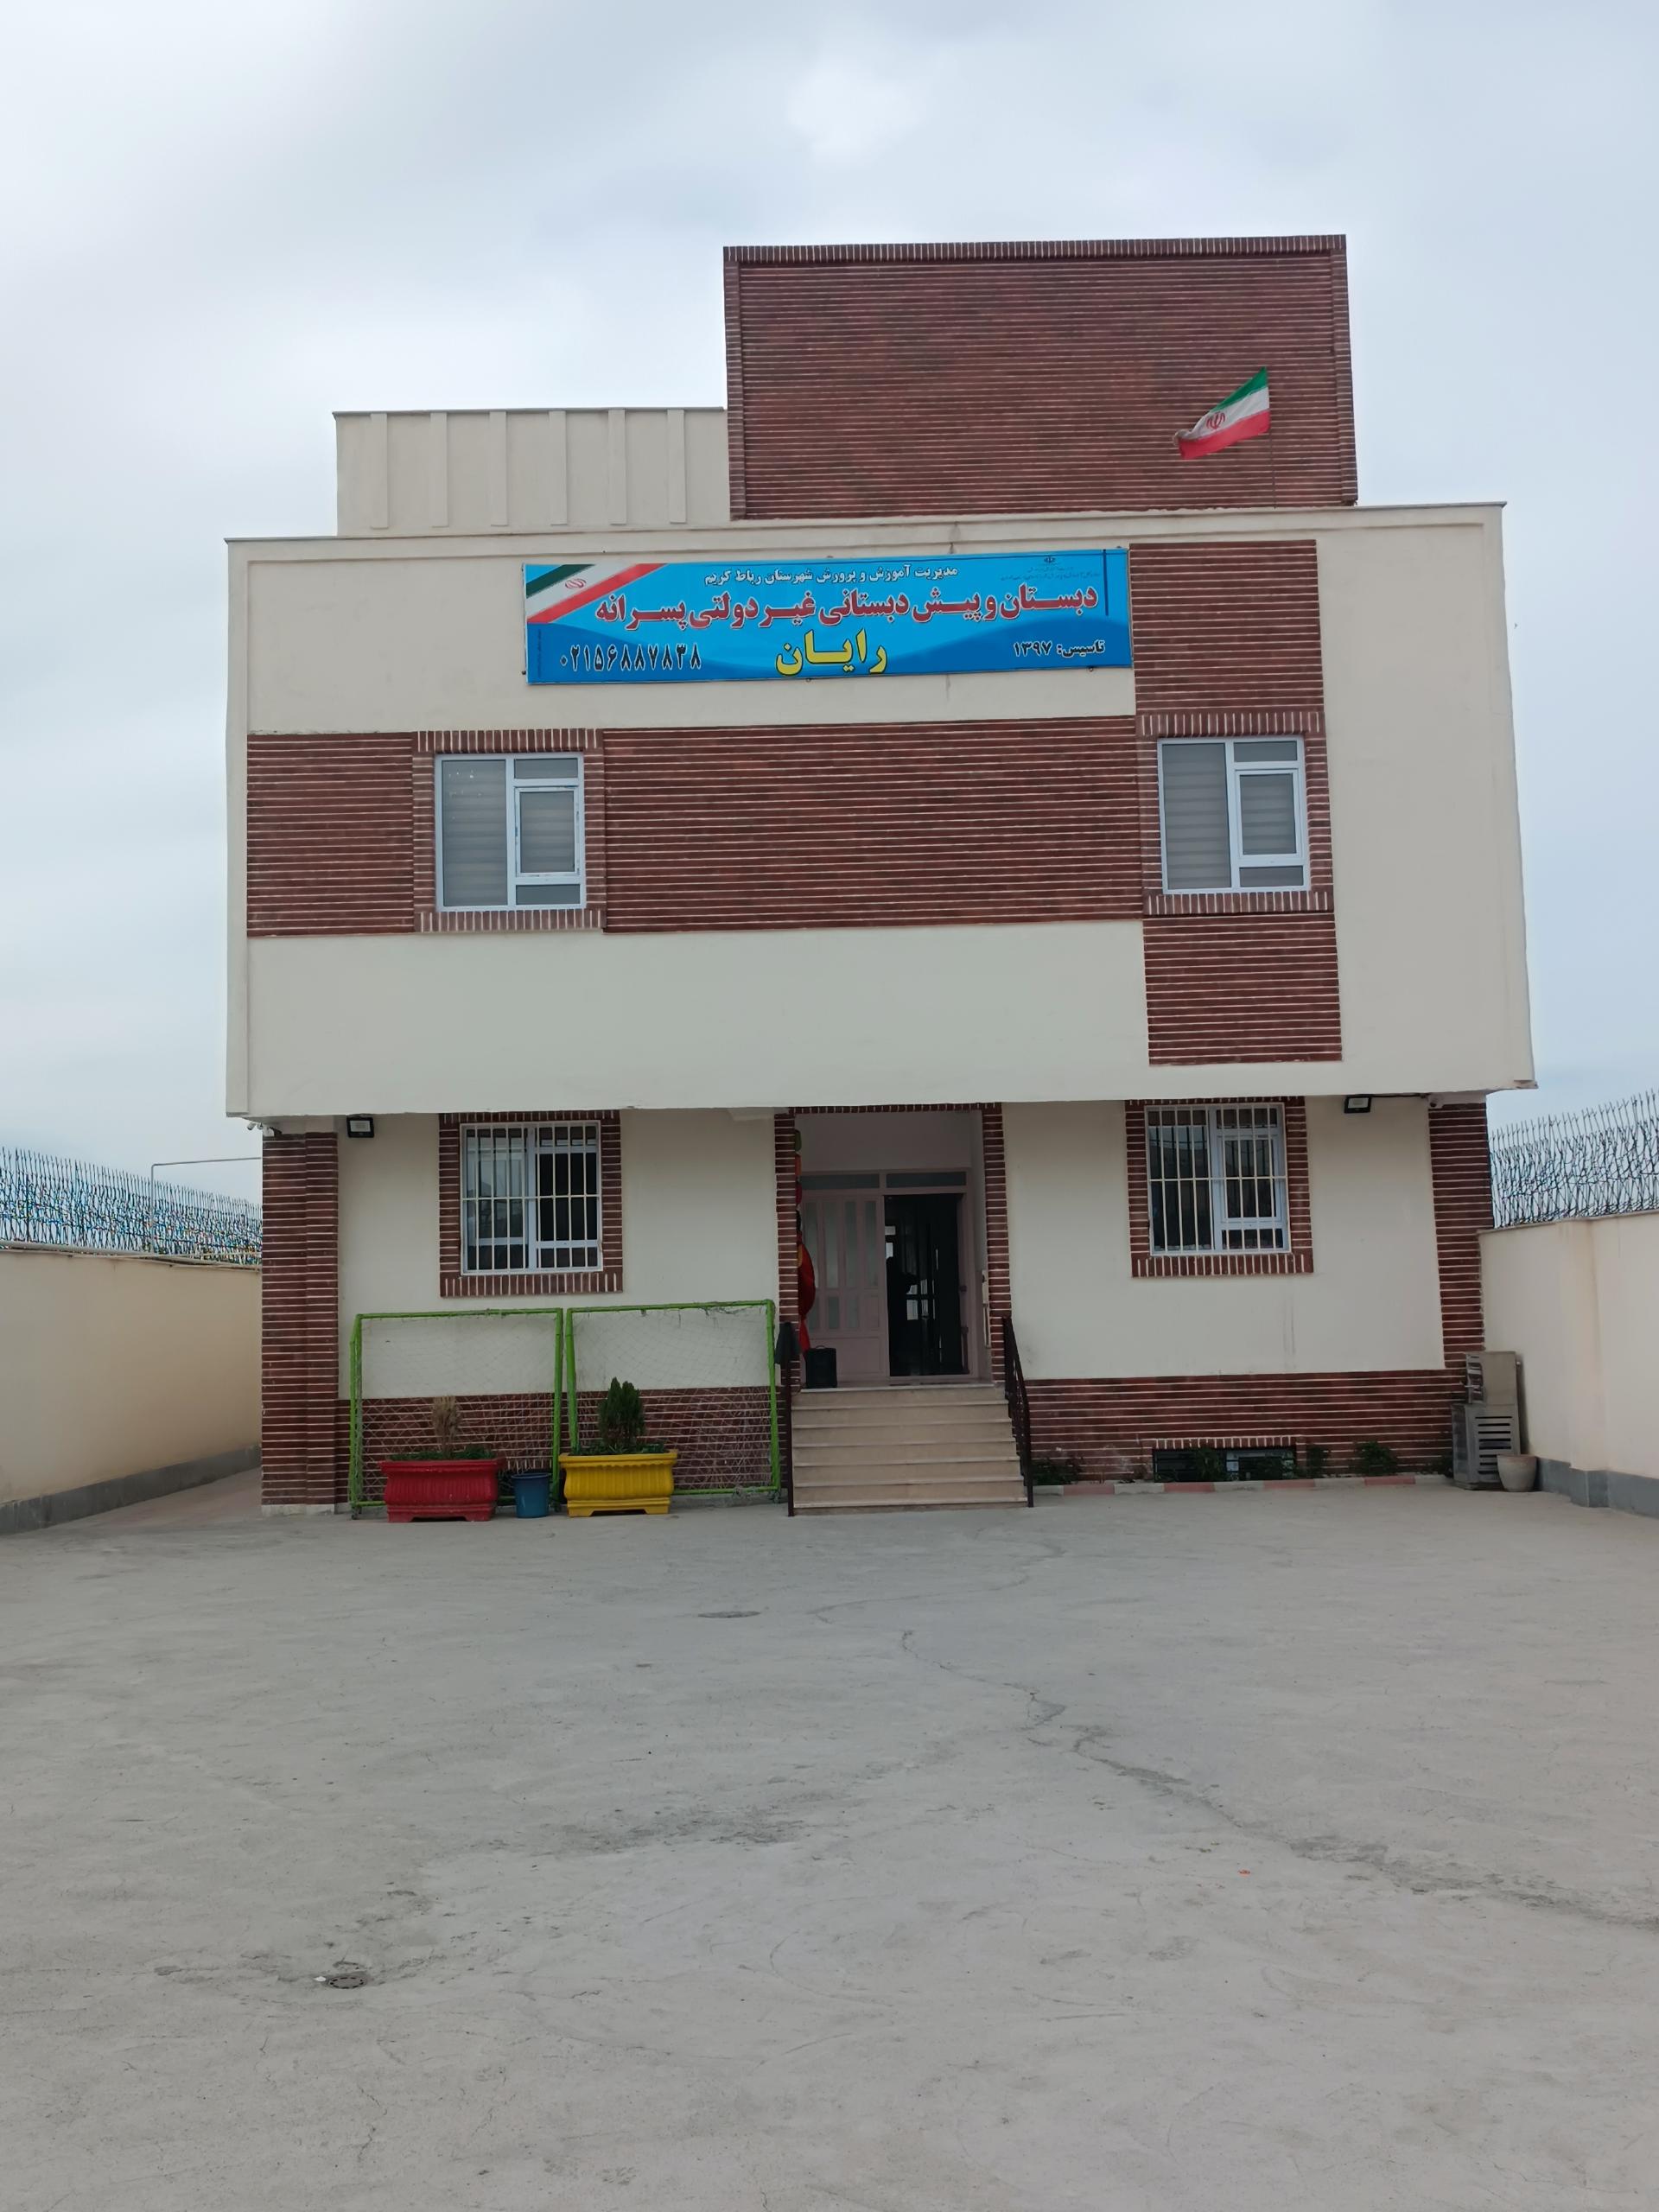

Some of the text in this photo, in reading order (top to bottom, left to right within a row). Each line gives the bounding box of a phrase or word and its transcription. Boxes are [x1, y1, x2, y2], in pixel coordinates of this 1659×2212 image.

[704, 563, 958, 585] مدیریت آموزش و پرورش شهرستان رباط کریم
[595, 583, 1098, 631] دبستان و پیش دبستانی غیر دولتی پسرانه
[776, 627, 888, 677] رایان
[1014, 639, 1105, 658] تاسیس: ۱۳۹۷
